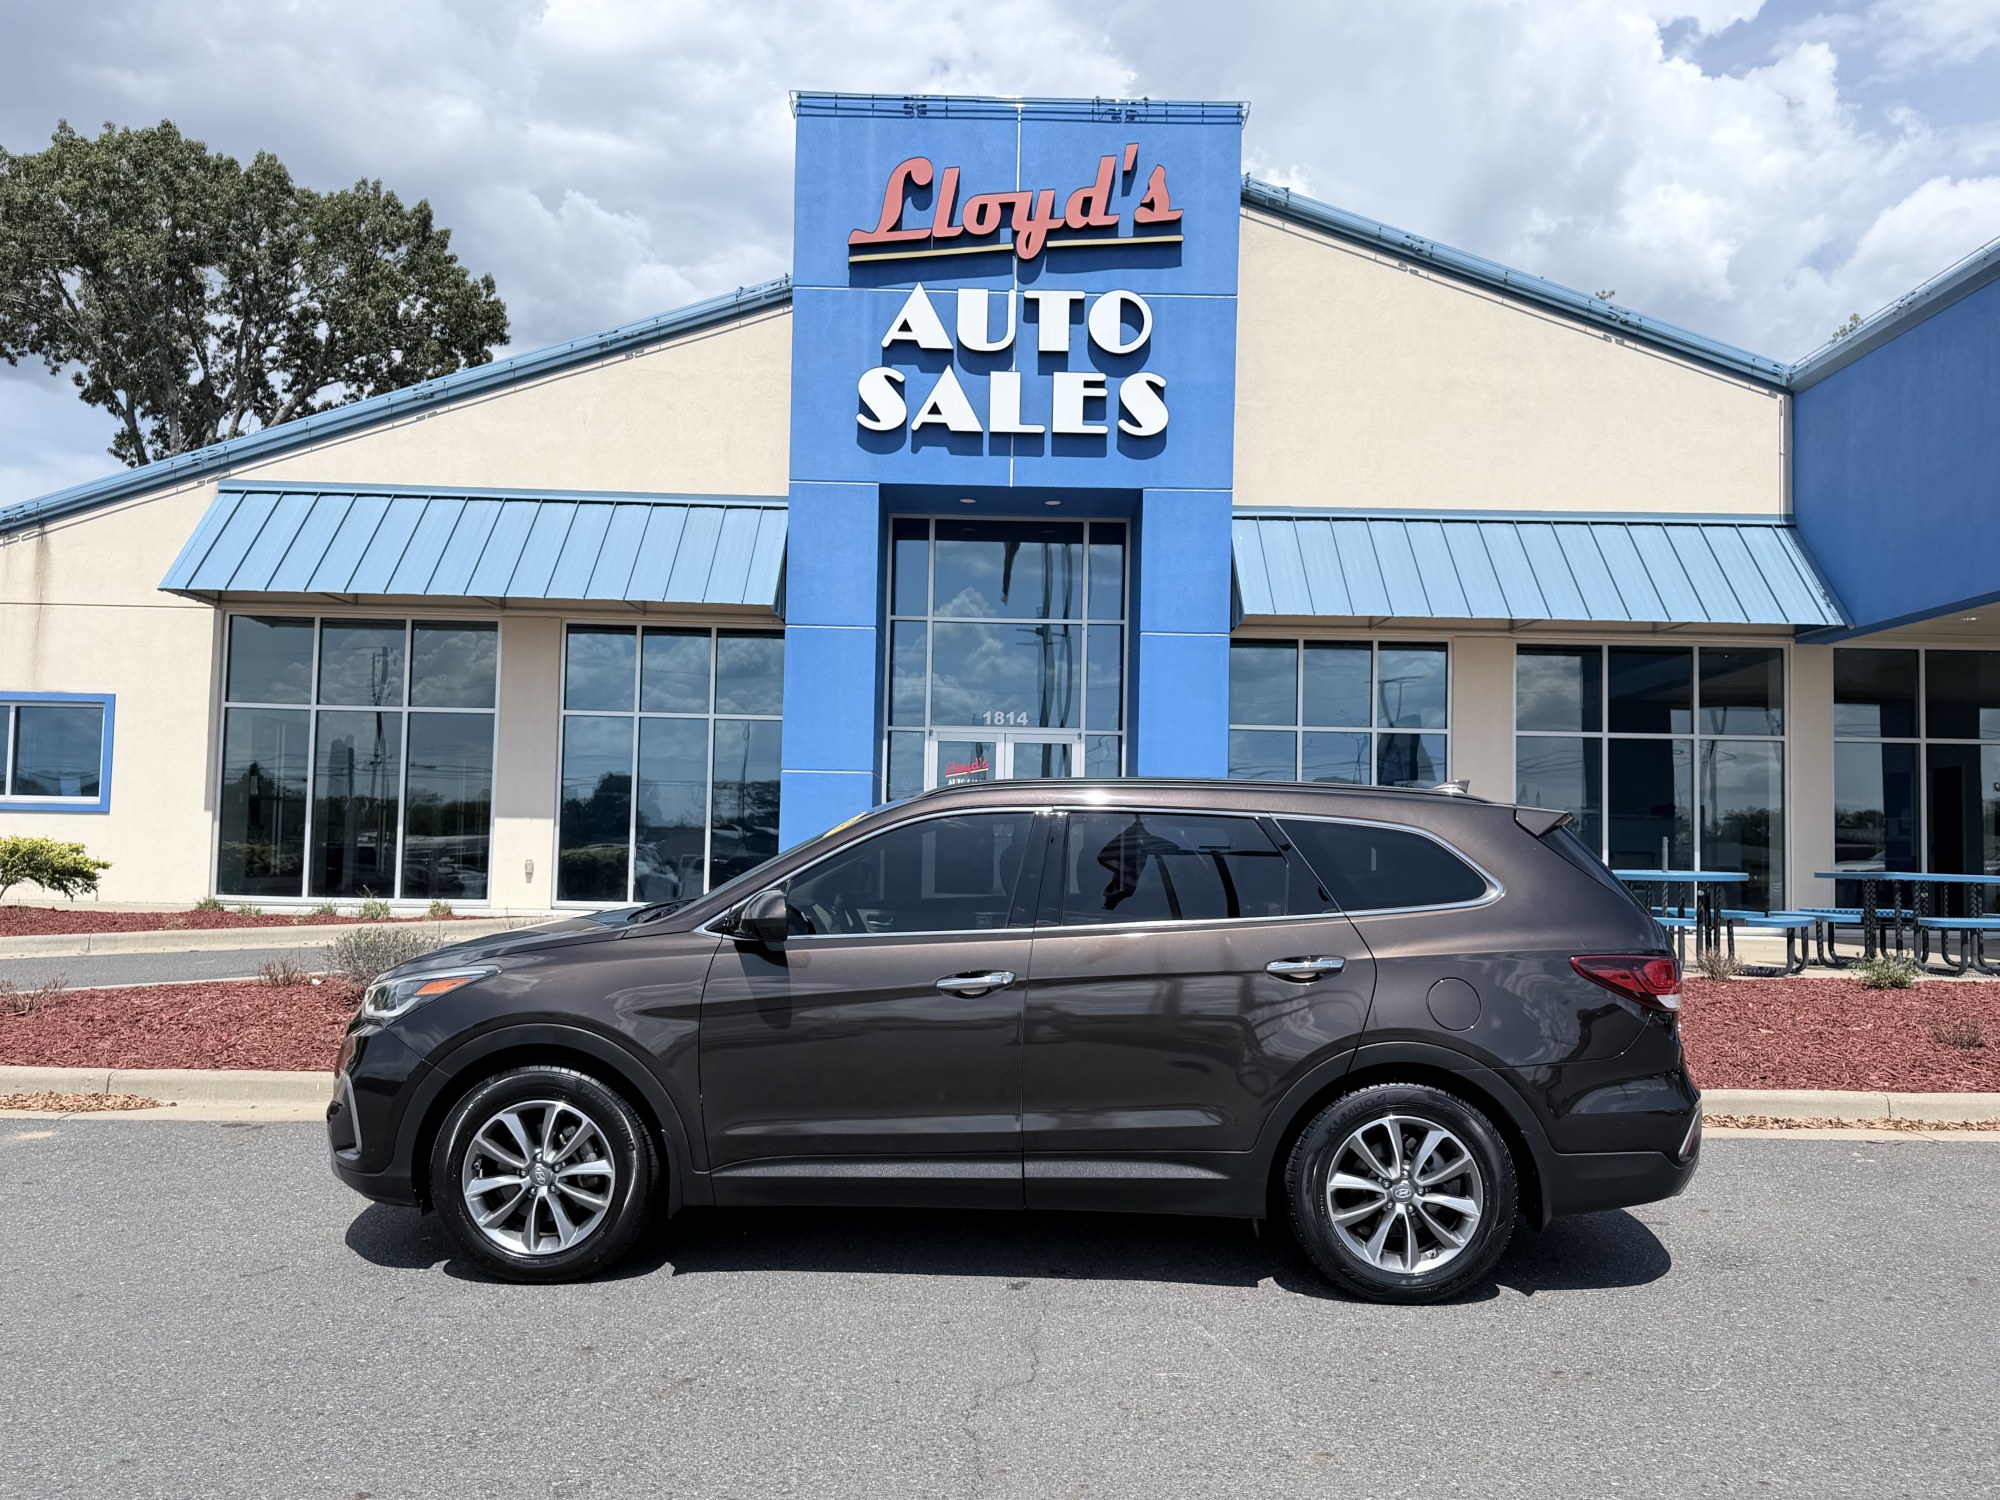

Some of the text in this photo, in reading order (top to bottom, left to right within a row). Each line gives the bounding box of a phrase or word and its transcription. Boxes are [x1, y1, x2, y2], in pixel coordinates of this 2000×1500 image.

[848, 143, 1184, 260] Lloyd's
[880, 281, 1153, 354] AUTO
[856, 364, 1169, 437] SALES
[982, 710, 1029, 726] 1814
[945, 757, 989, 775] Lloyd's
[1325, 1098, 1375, 1135] KUMHO
